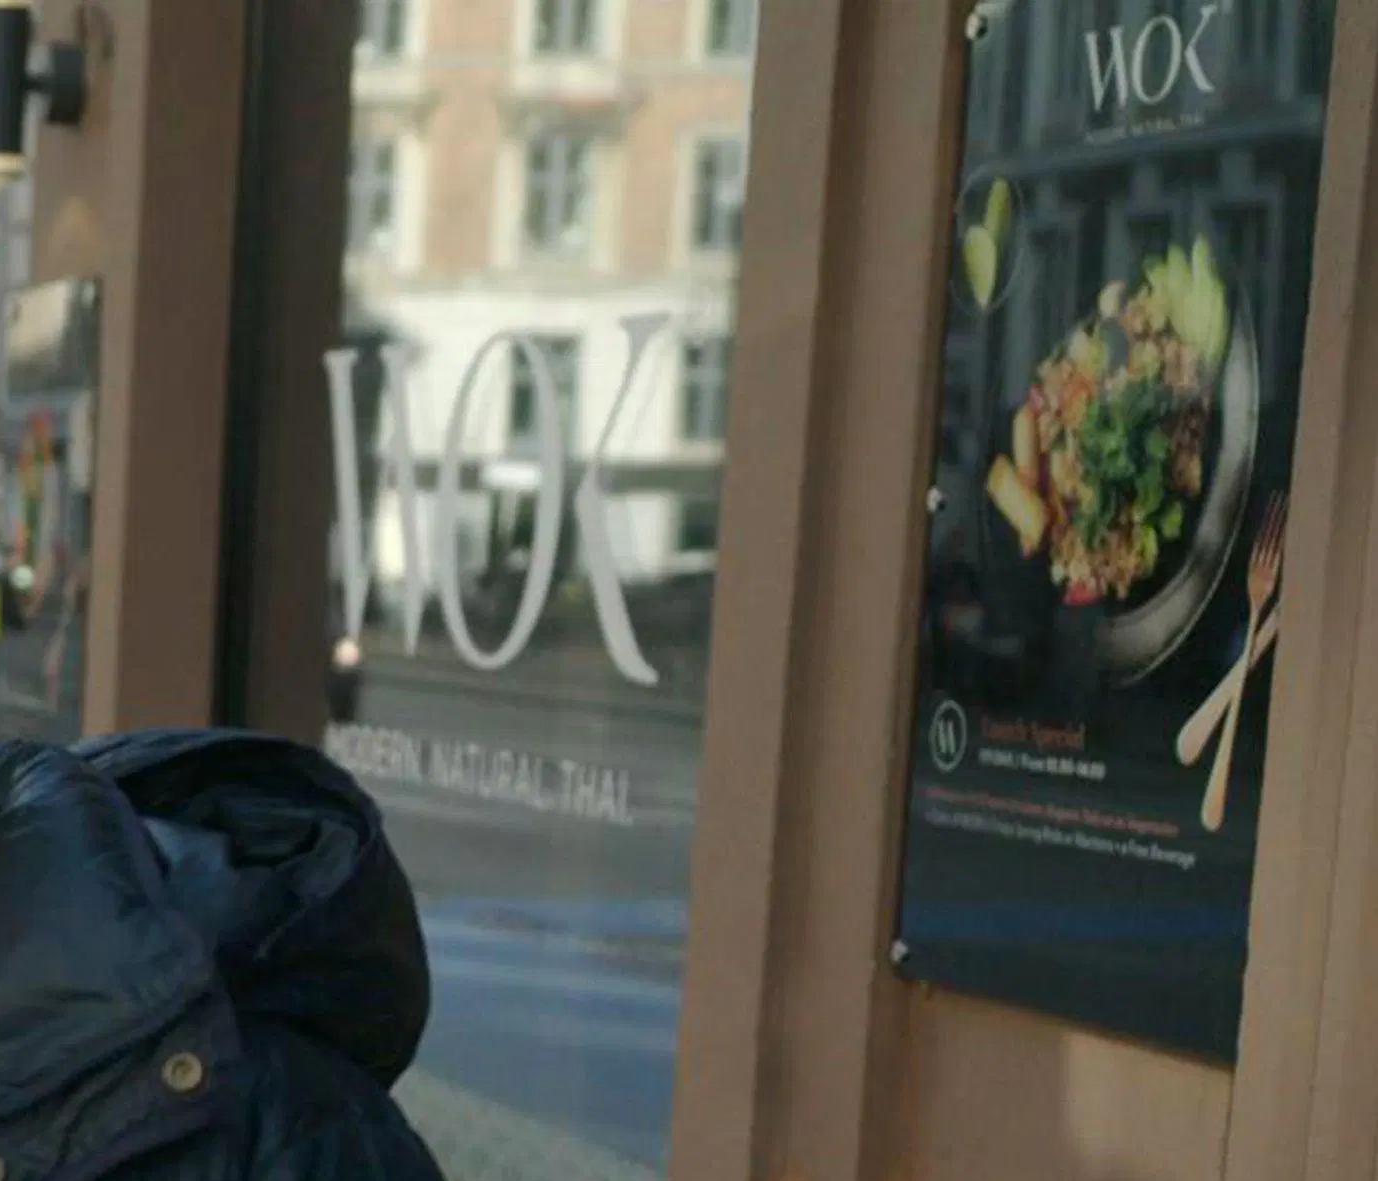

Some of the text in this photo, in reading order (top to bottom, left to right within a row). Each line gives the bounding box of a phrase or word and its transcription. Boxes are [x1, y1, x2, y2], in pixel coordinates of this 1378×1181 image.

[1084, 5, 1218, 112] WOK
[323, 313, 669, 686] WOK
[430, 738, 556, 810] NATURAL
